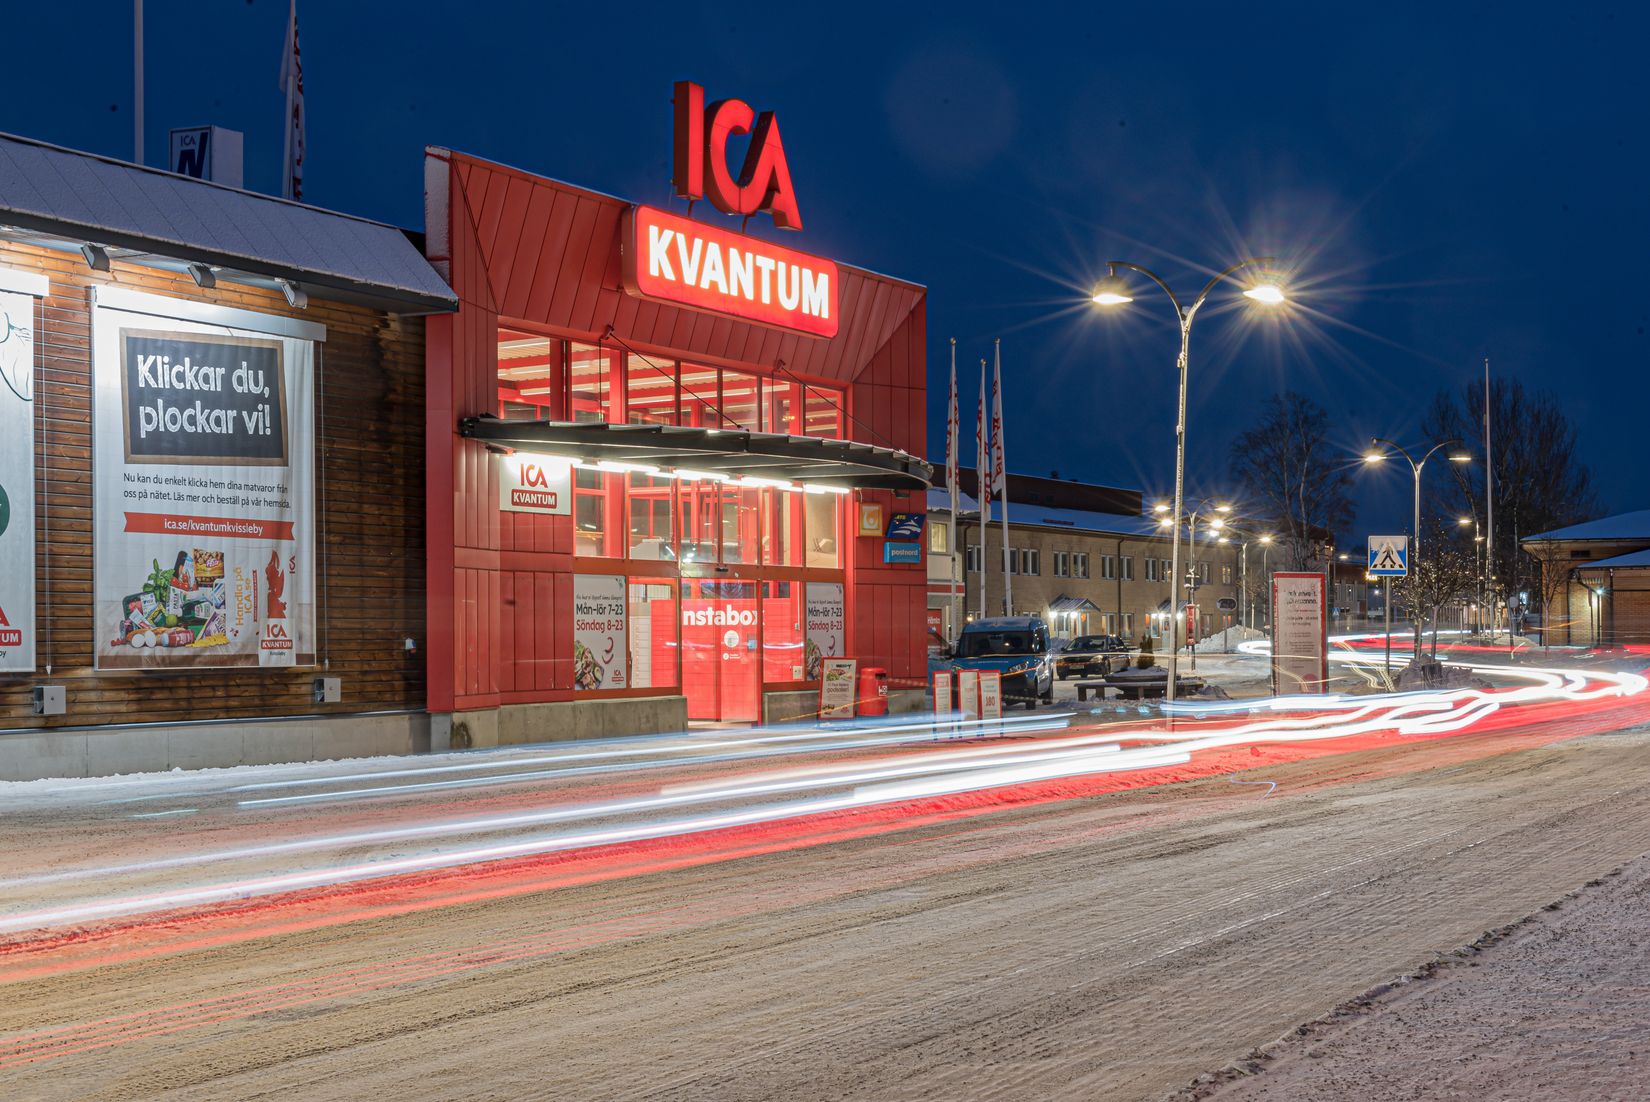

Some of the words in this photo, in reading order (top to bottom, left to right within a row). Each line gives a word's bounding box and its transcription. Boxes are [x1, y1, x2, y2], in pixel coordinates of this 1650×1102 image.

[180, 135, 196, 147] ICA
[674, 80, 803, 231] ICA
[649, 225, 829, 319] KVANTUM
[137, 354, 225, 391] Klickar
[232, 361, 270, 398] du,
[139, 399, 237, 438] plockar
[242, 404, 272, 435] vi!
[123, 473, 136, 482] Nu
[137, 473, 152, 483] kan
[153, 474, 163, 484] du
[164, 475, 187, 486] enkelt
[187, 477, 208, 488] klicka
[209, 479, 225, 489] hem
[227, 480, 243, 491] dina
[243, 483, 275, 492] matvaror
[520, 463, 549, 488] ICA
[123, 490, 137, 498] oss
[138, 489, 148, 500] på
[149, 490, 173, 500] nätet.
[173, 491, 185, 501] Läs
[185, 494, 201, 502] mer
[201, 493, 215, 503] och
[216, 494, 240, 505] beställ
[241, 497, 250, 508] på
[251, 497, 262, 507] vår
[513, 491, 556, 505] KVANTUM
[164, 518, 264, 536] ica.se/kvantumkvissleby
[891, 548, 919, 557] postnord
[234, 585, 244, 626] Handla
[576, 602, 607, 616] Mån-lör
[608, 603, 624, 616] 7-23
[830, 607, 843, 617] 7-23
[266, 624, 288, 638] ICA
[576, 619, 606, 633] Söndag
[607, 621, 624, 631] 8-23
[808, 620, 830, 632] Söndag
